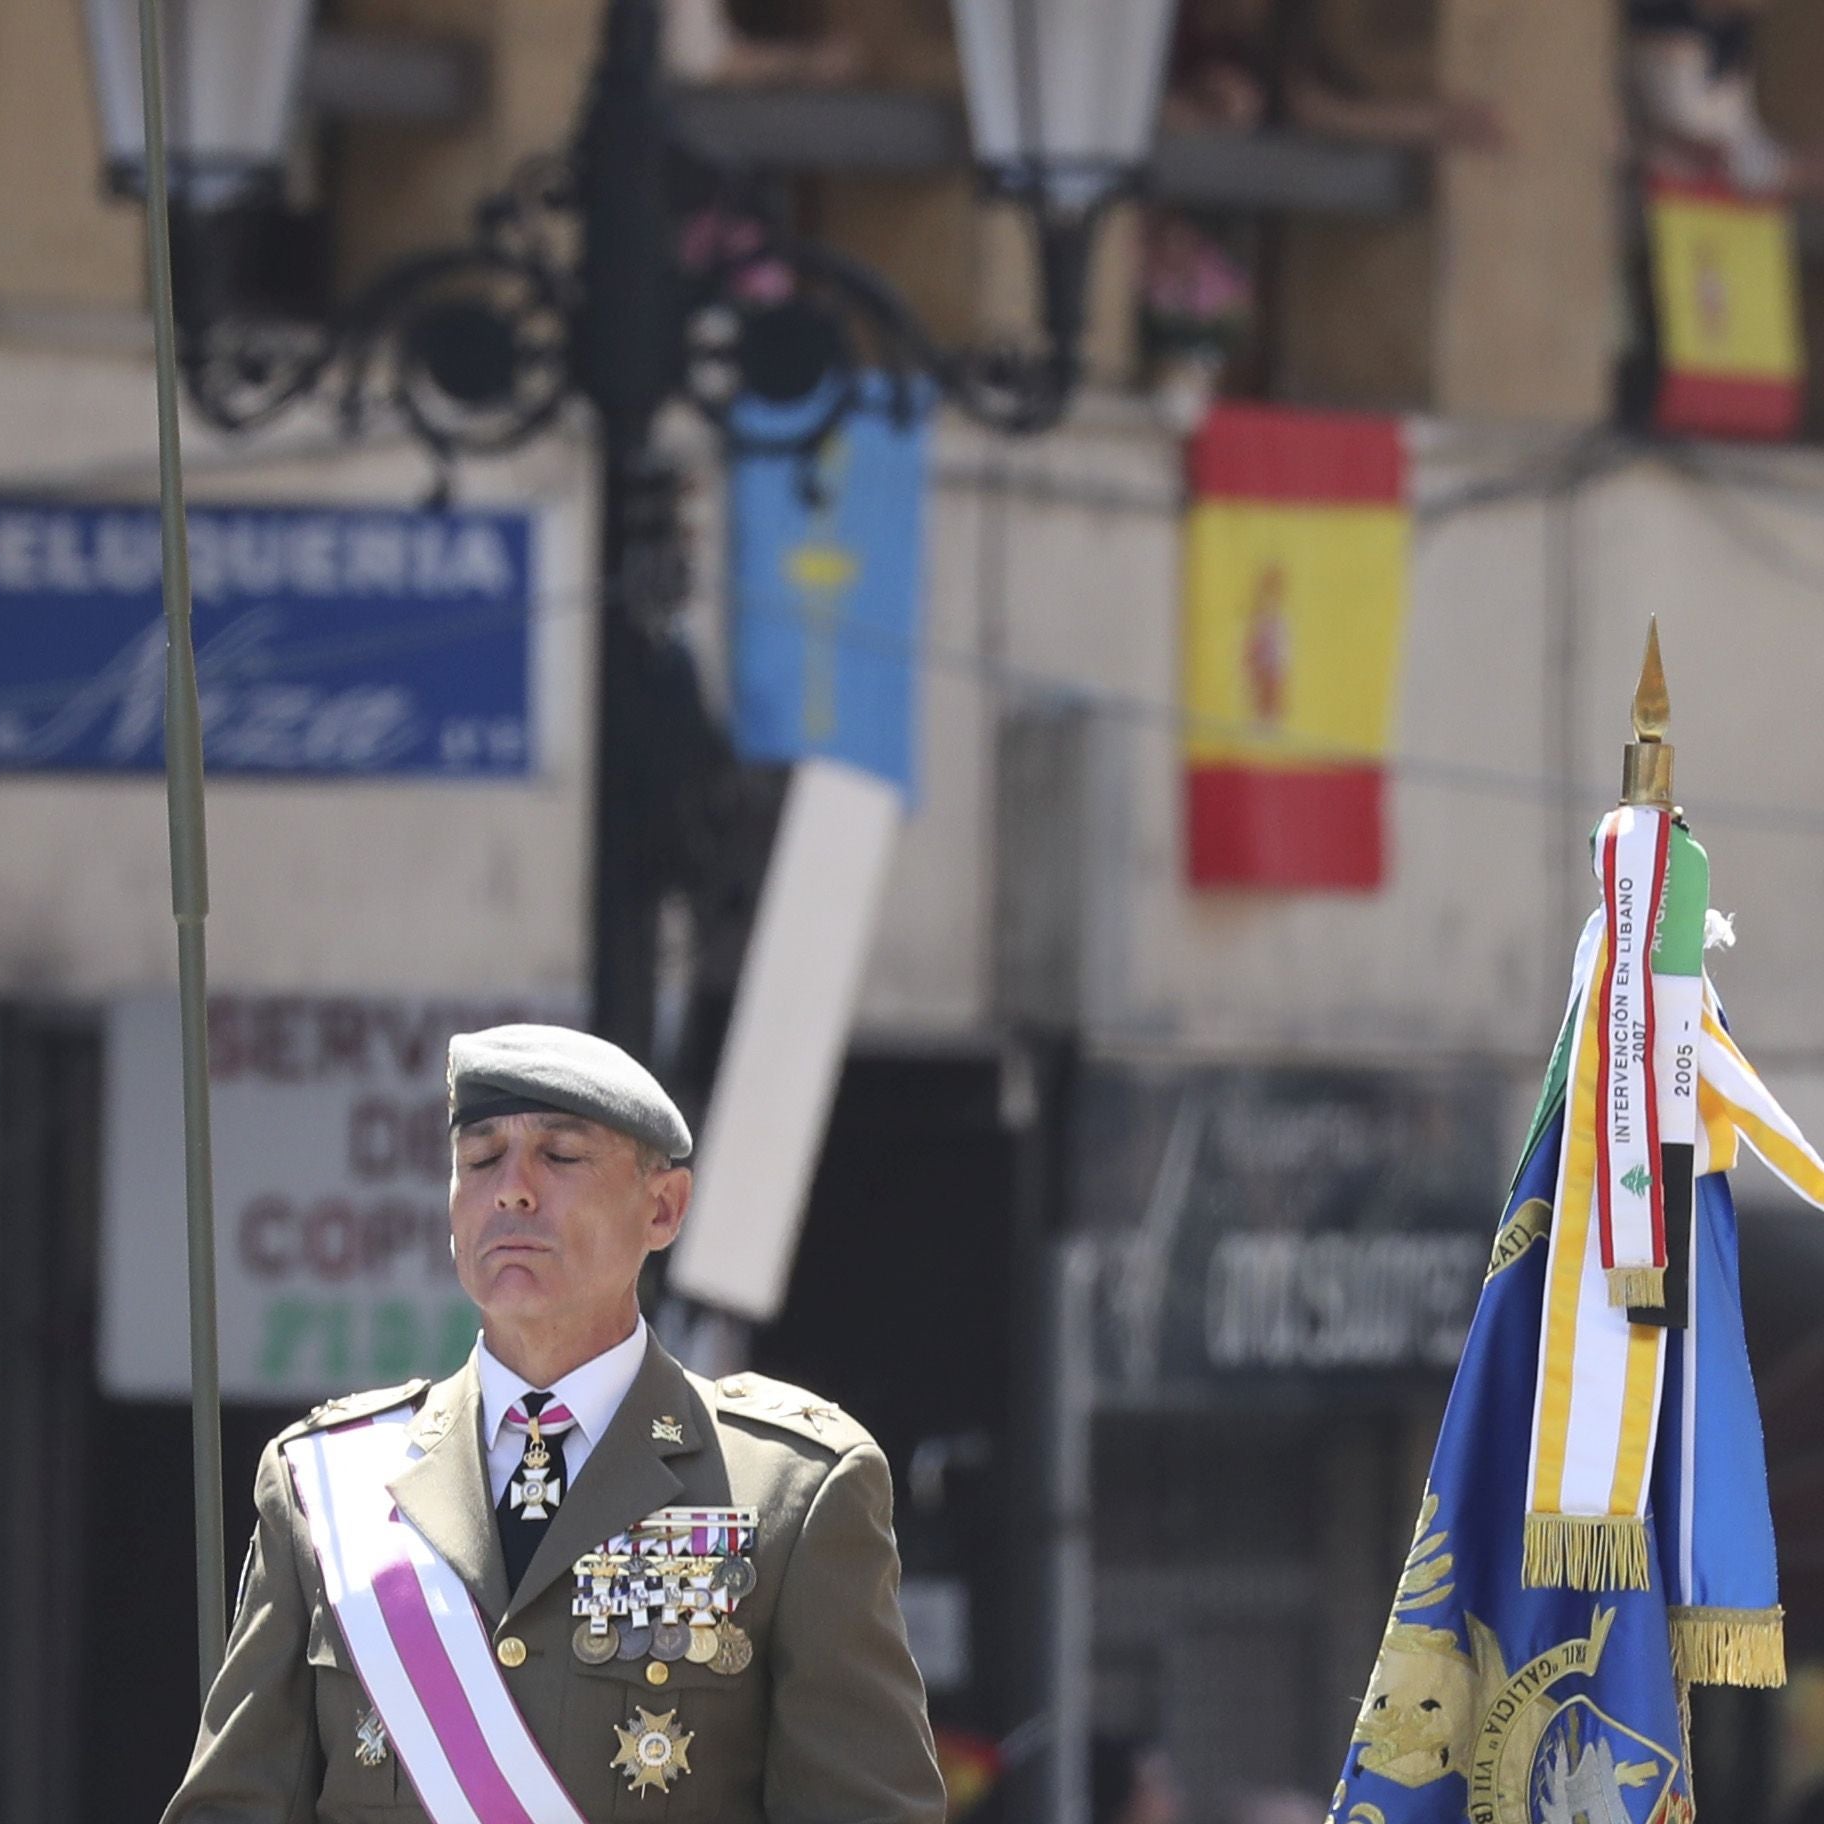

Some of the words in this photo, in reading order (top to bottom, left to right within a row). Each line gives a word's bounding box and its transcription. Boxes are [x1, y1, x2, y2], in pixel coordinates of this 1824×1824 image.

[1616, 962, 1631, 986] EN
[1633, 1021, 1648, 1063] 2007
[1610, 994, 1631, 1144] INTERVENCIÓN
[1674, 1044, 1694, 1097] 2005
[1474, 1761, 1494, 1793] VII
